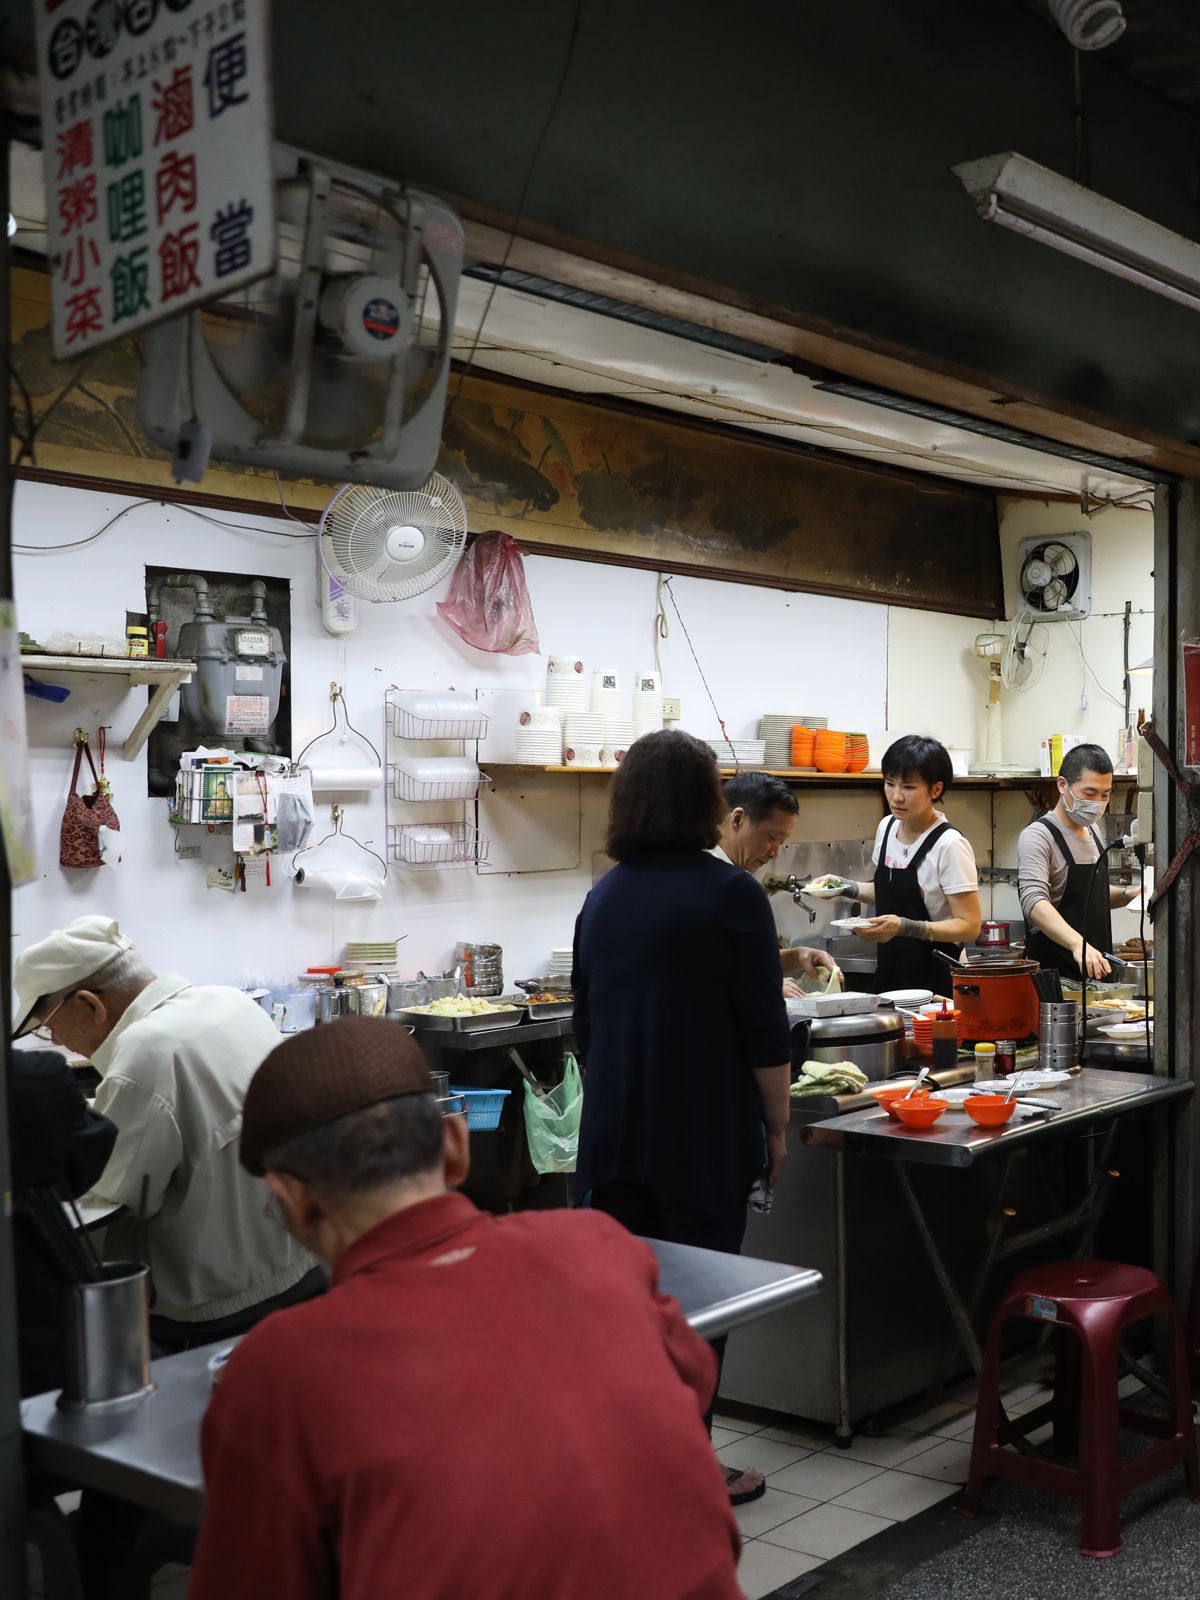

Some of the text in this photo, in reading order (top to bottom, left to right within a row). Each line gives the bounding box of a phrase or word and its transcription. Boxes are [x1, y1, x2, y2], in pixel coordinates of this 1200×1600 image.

[56, 118, 104, 346] 清粥小菜
[104, 94, 151, 324] 咖哩飯
[152, 65, 203, 302] 滷肉飯
[204, 33, 254, 278] 便當
